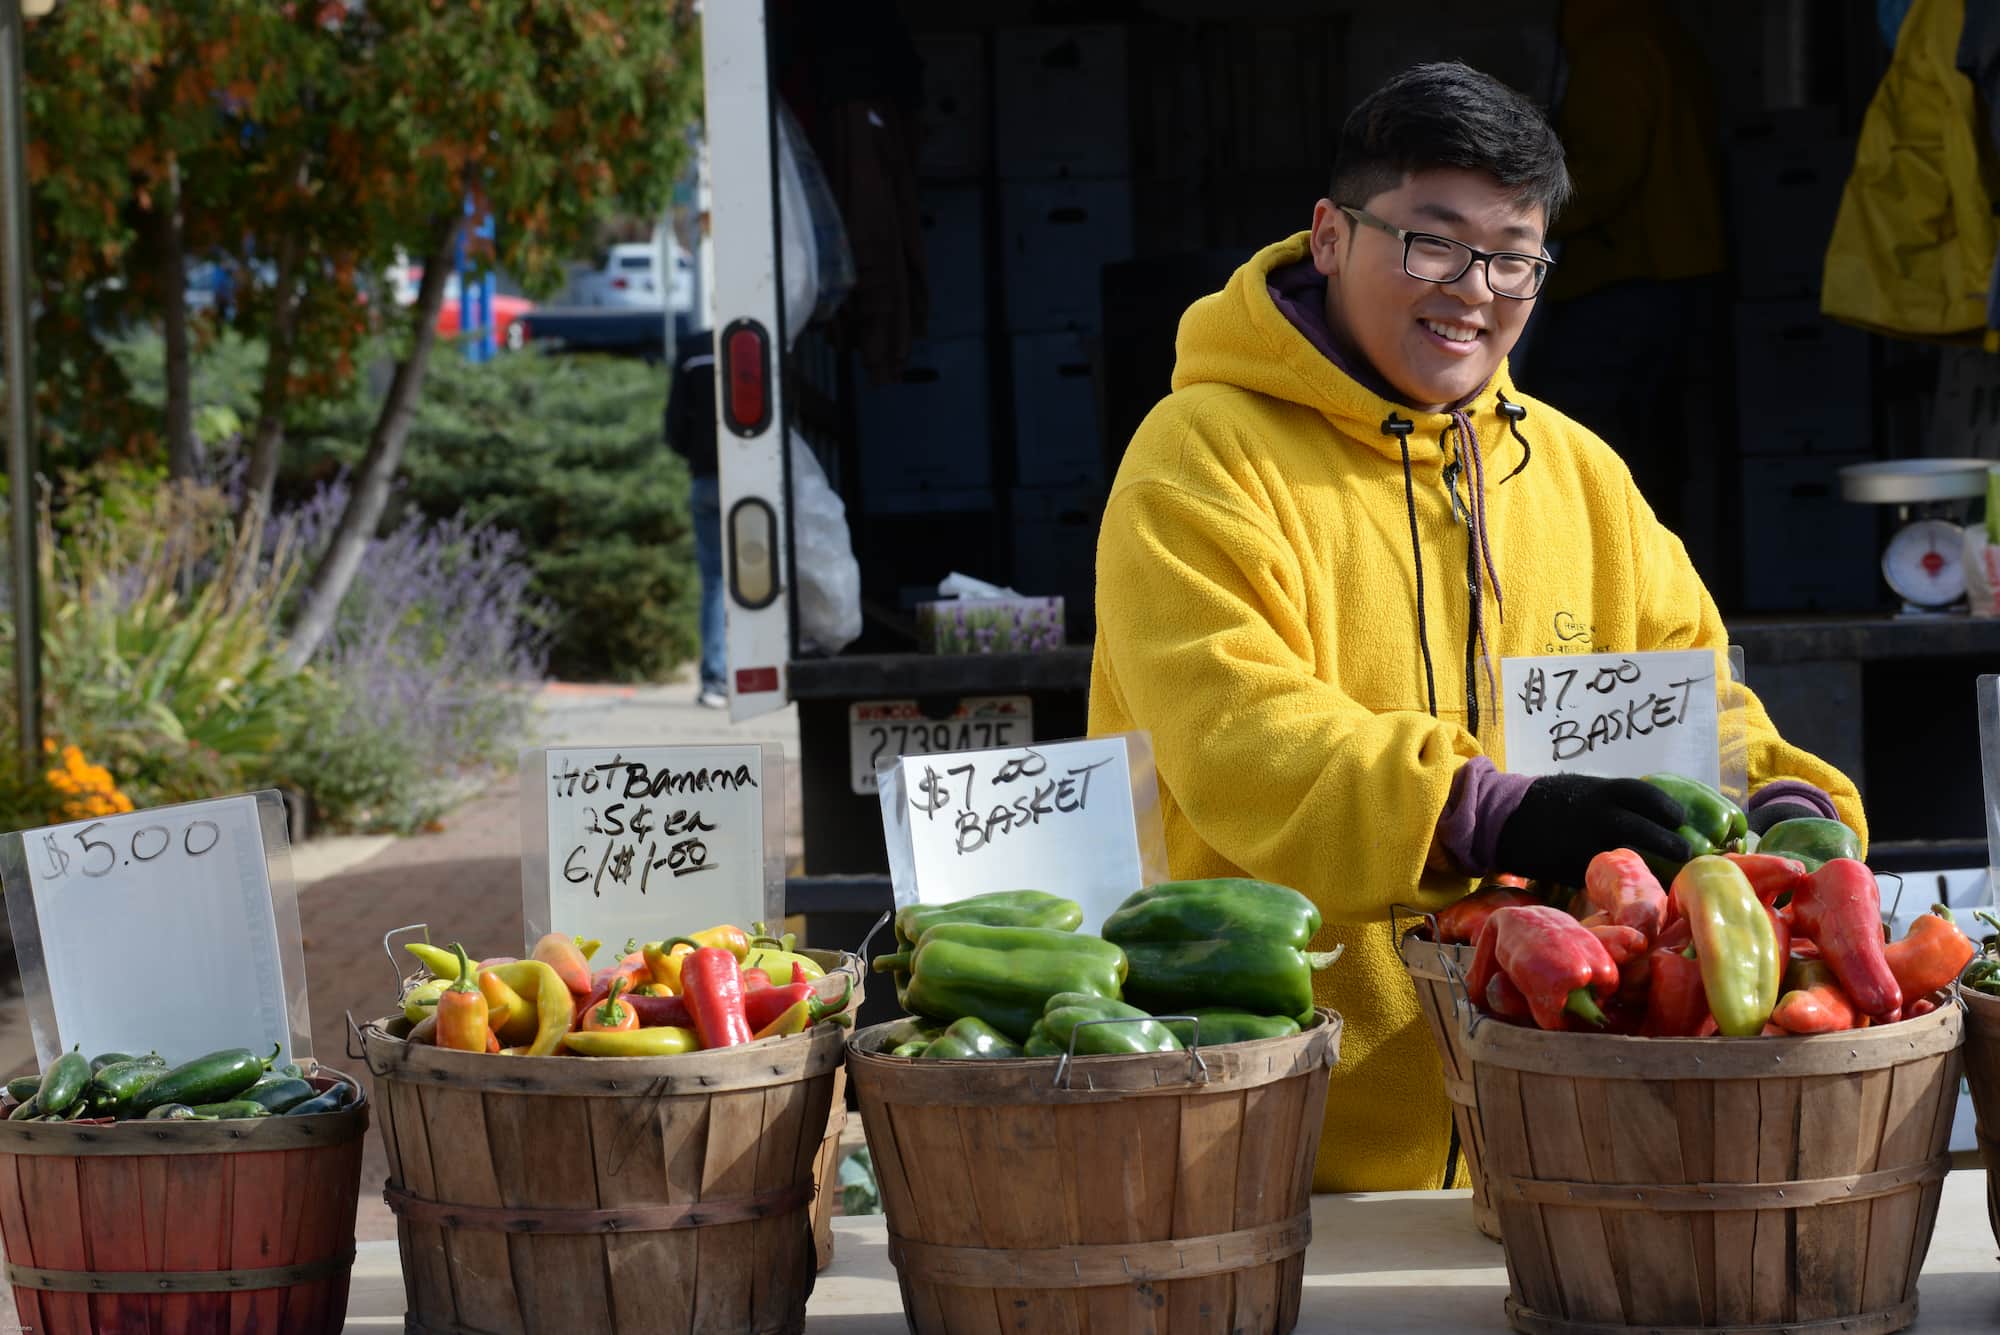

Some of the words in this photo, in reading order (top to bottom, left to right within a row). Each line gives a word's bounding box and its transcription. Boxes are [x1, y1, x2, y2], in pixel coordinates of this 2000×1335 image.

[1549, 674, 1715, 762] BASKET
[955, 757, 1114, 855] BASKET
[41, 821, 220, 880] $5.00
